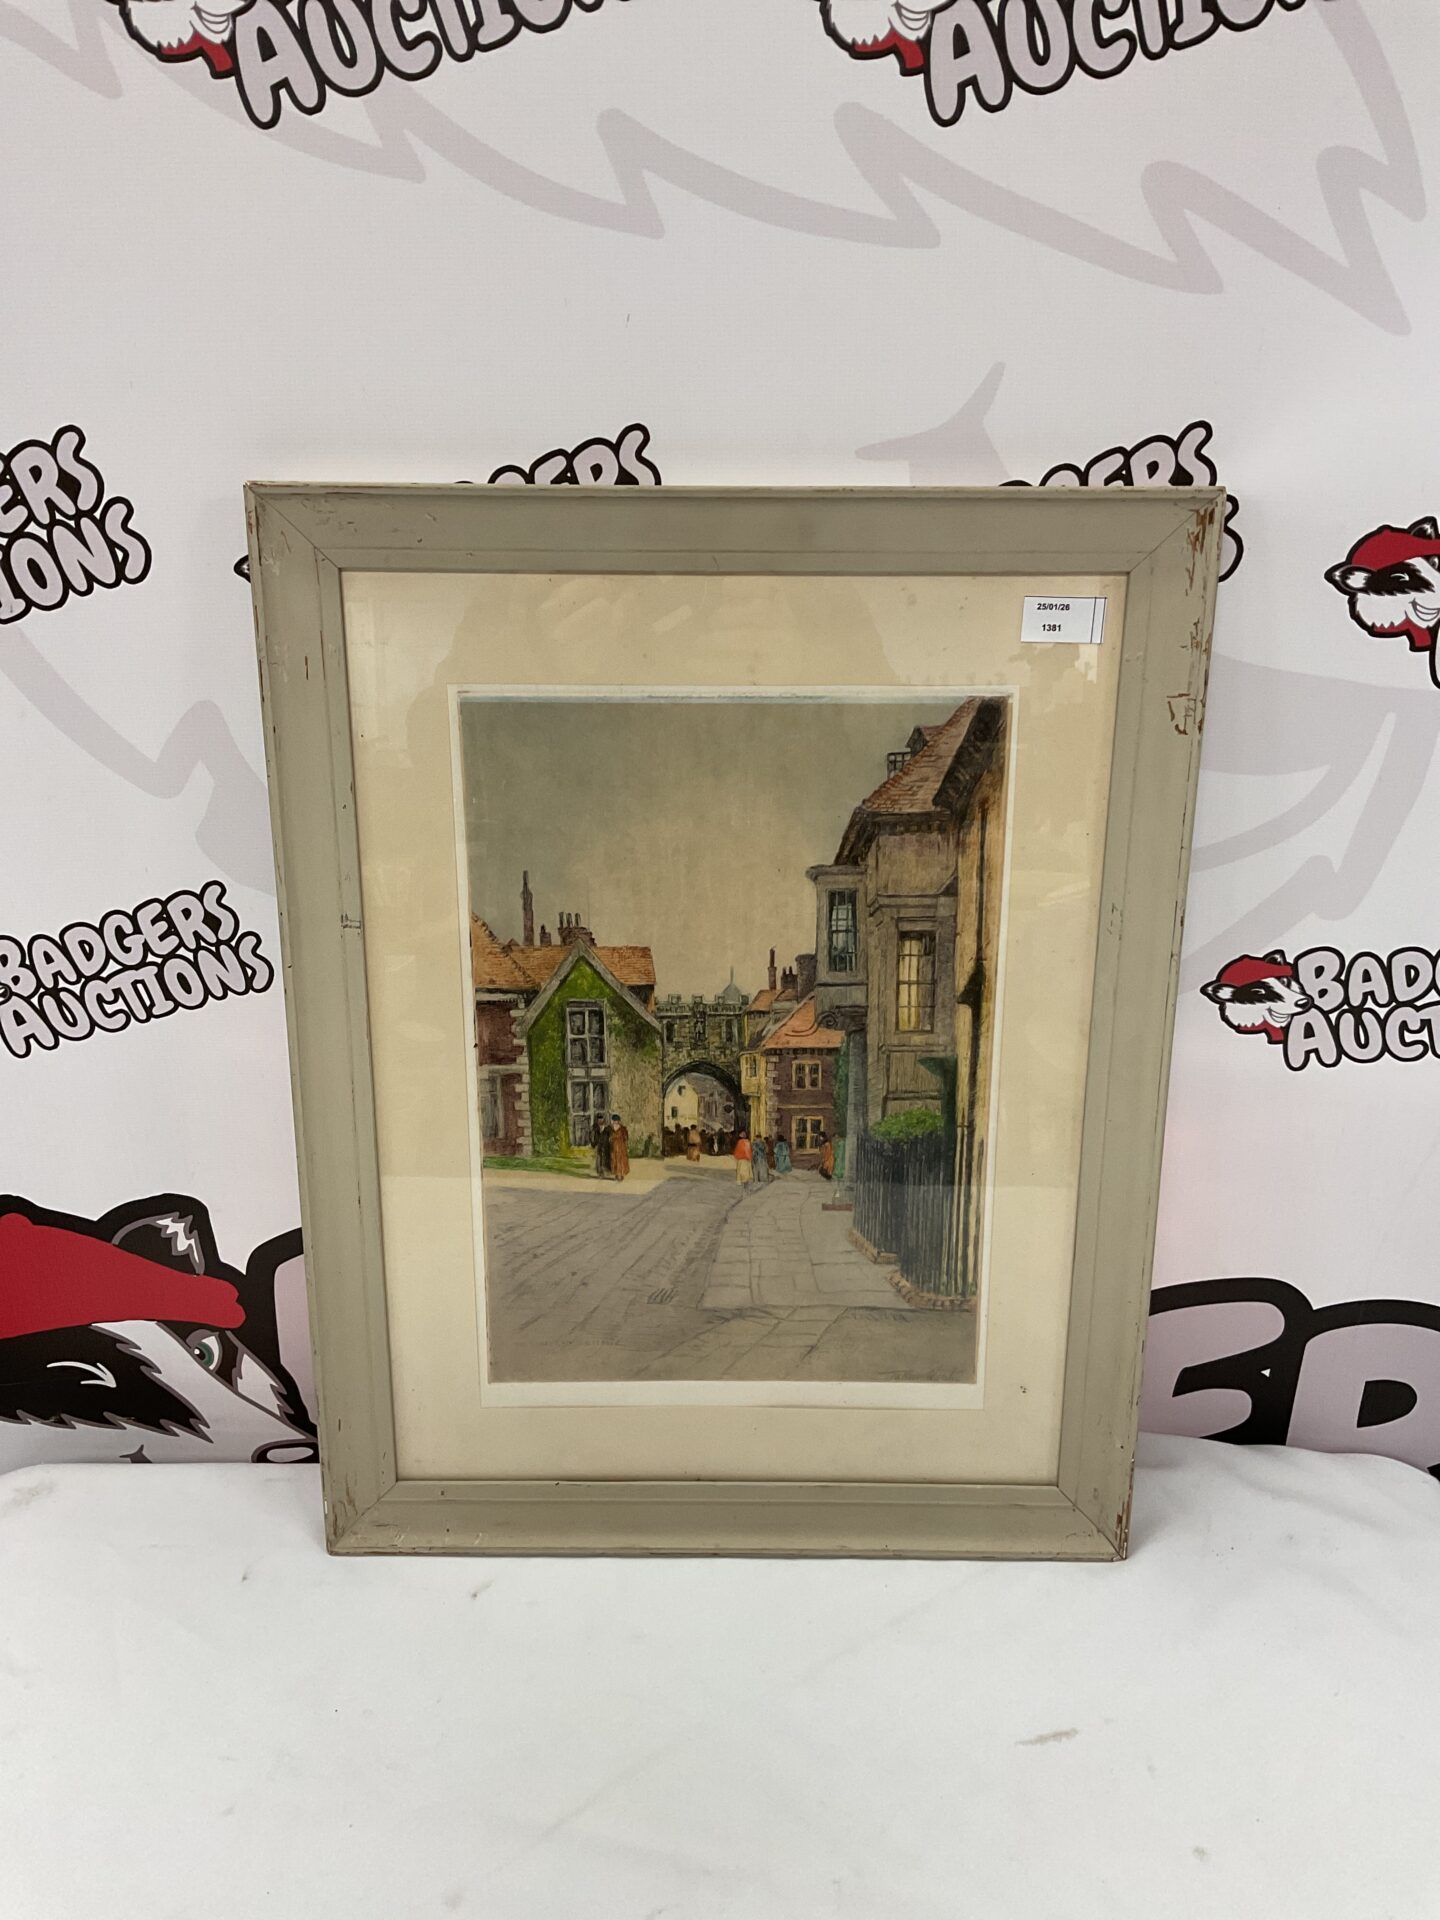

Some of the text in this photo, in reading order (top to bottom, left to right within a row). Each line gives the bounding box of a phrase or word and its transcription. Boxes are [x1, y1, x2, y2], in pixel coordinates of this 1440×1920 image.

[233, 0, 615, 130] AUCTI
[922, 0, 1316, 127] AUCTI
[1036, 603, 1071, 611] 25/01/26
[1041, 623, 1062, 632] 1381
[0, 880, 240, 999] BADGERS
[0, 931, 274, 1058] AUCTIONS
[1293, 946, 1440, 1012] BAD
